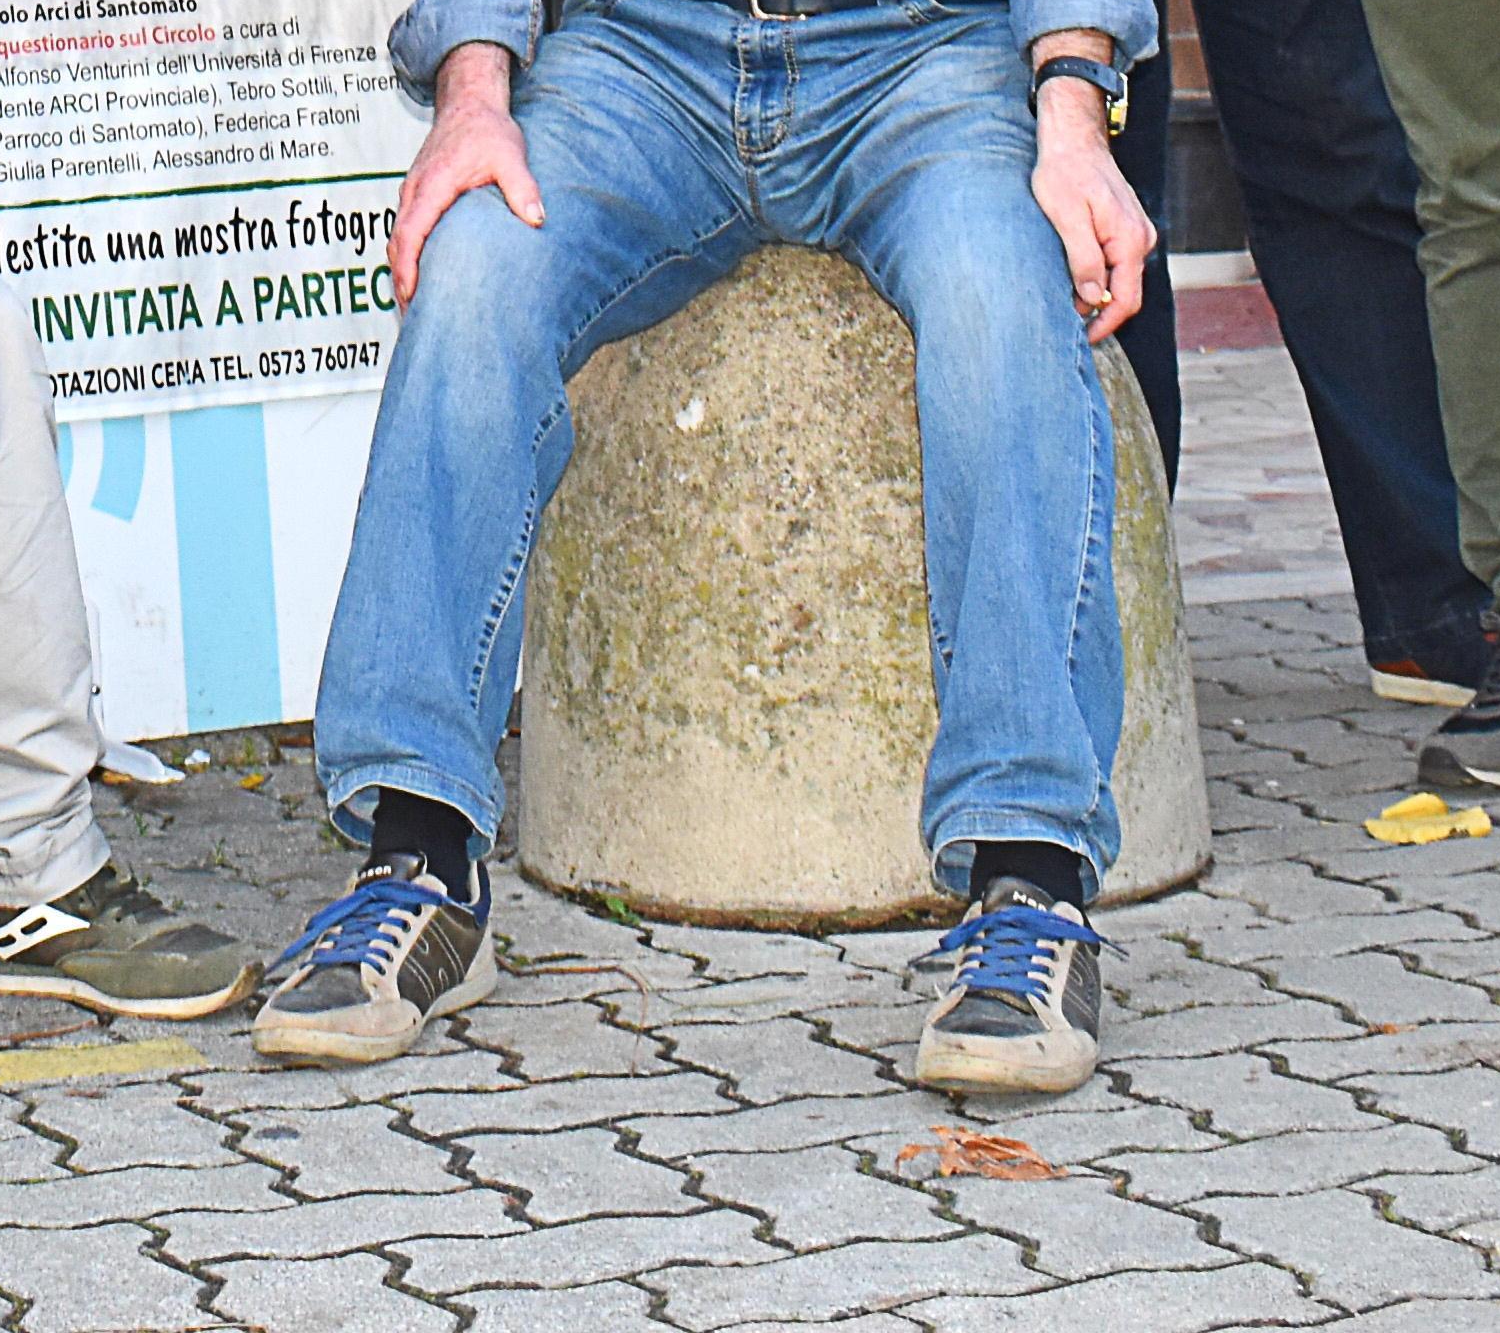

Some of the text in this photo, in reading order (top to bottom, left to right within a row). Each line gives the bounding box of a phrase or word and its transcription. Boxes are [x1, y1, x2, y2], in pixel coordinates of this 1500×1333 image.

[34, 1, 70, 23] Arci
[74, 0, 92, 20] di
[119, 26, 148, 49] sul
[152, 22, 217, 46] Circolo
[222, 24, 235, 41] a
[239, 21, 278, 40] cura
[282, 15, 301, 37] di
[67, 59, 151, 85] Venturini
[155, 48, 283, 77] dell'Università
[288, 48, 306, 69] di
[310, 42, 378, 66] Firenze
[50, 92, 100, 116] ARCI
[105, 82, 223, 112] Provinciale),
[226, 76, 277, 103] Tebro
[281, 74, 339, 101] Sottili,
[343, 71, 402, 95] Fioren
[69, 124, 86, 146] di
[92, 116, 209, 145] Santomato),
[213, 109, 291, 135] Federica
[296, 102, 362, 129] Fratoni
[50, 151, 148, 180] Parentelli,
[152, 143, 256, 171] Alessandro
[258, 139, 275, 162] di
[279, 138, 336, 161] Mare.
[107, 231, 166, 263] una
[175, 206, 279, 258] mostra
[285, 199, 397, 257] fotogra
[32, 264, 396, 345] INVITATA A PARTEC
[150, 357, 206, 390] CENA
[209, 352, 254, 382] TEL.
[258, 349, 307, 379] 0573
[310, 341, 381, 373] 760747
